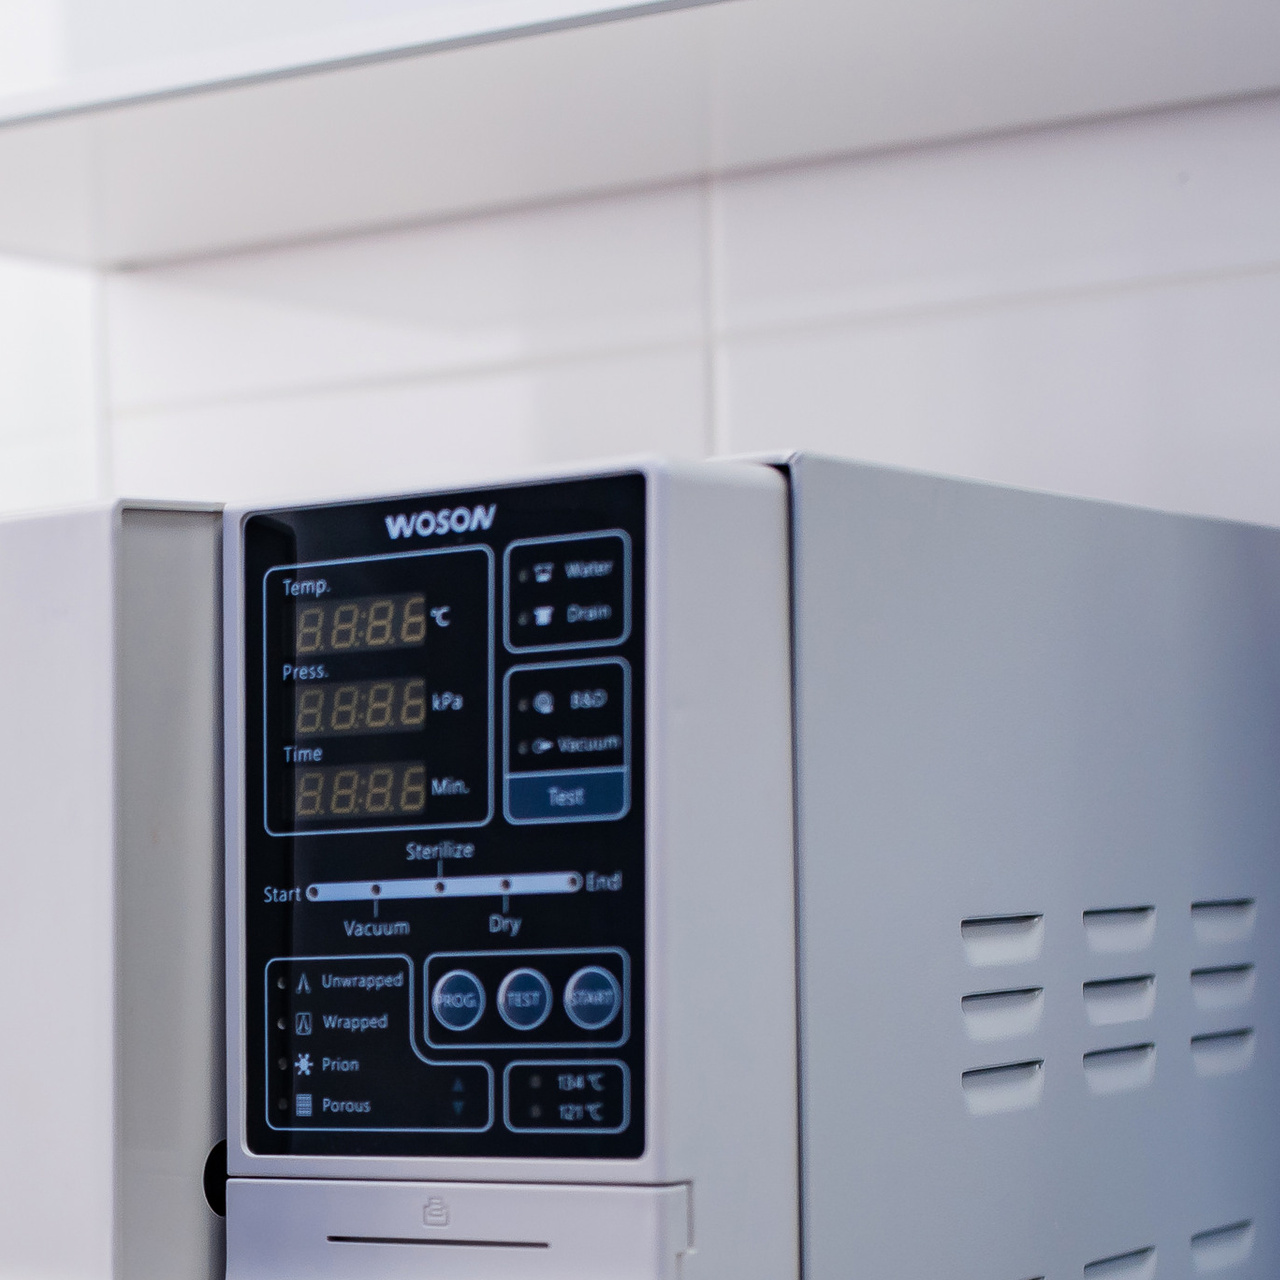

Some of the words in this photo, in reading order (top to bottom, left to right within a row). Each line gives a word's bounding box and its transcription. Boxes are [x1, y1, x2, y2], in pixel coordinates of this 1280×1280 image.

[385, 502, 498, 540] WOSON
[564, 560, 614, 578] Water
[282, 577, 331, 597] Temp.
[566, 603, 612, 623] Drain
[282, 663, 329, 681] Press.
[431, 691, 464, 711] kPa
[283, 744, 323, 763] Time
[557, 735, 621, 753] Vacuum
[548, 785, 586, 807] Test
[405, 839, 476, 861] Sterilize
[585, 870, 623, 892] End
[263, 886, 302, 903] Start
[343, 920, 410, 937] Vacuum
[488, 912, 522, 937] Dry
[321, 971, 404, 991] Unwrapped
[507, 990, 541, 1007] TEST
[322, 1013, 389, 1033] Wrapped
[322, 1056, 360, 1072] Prion
[322, 1097, 372, 1114] Porous
